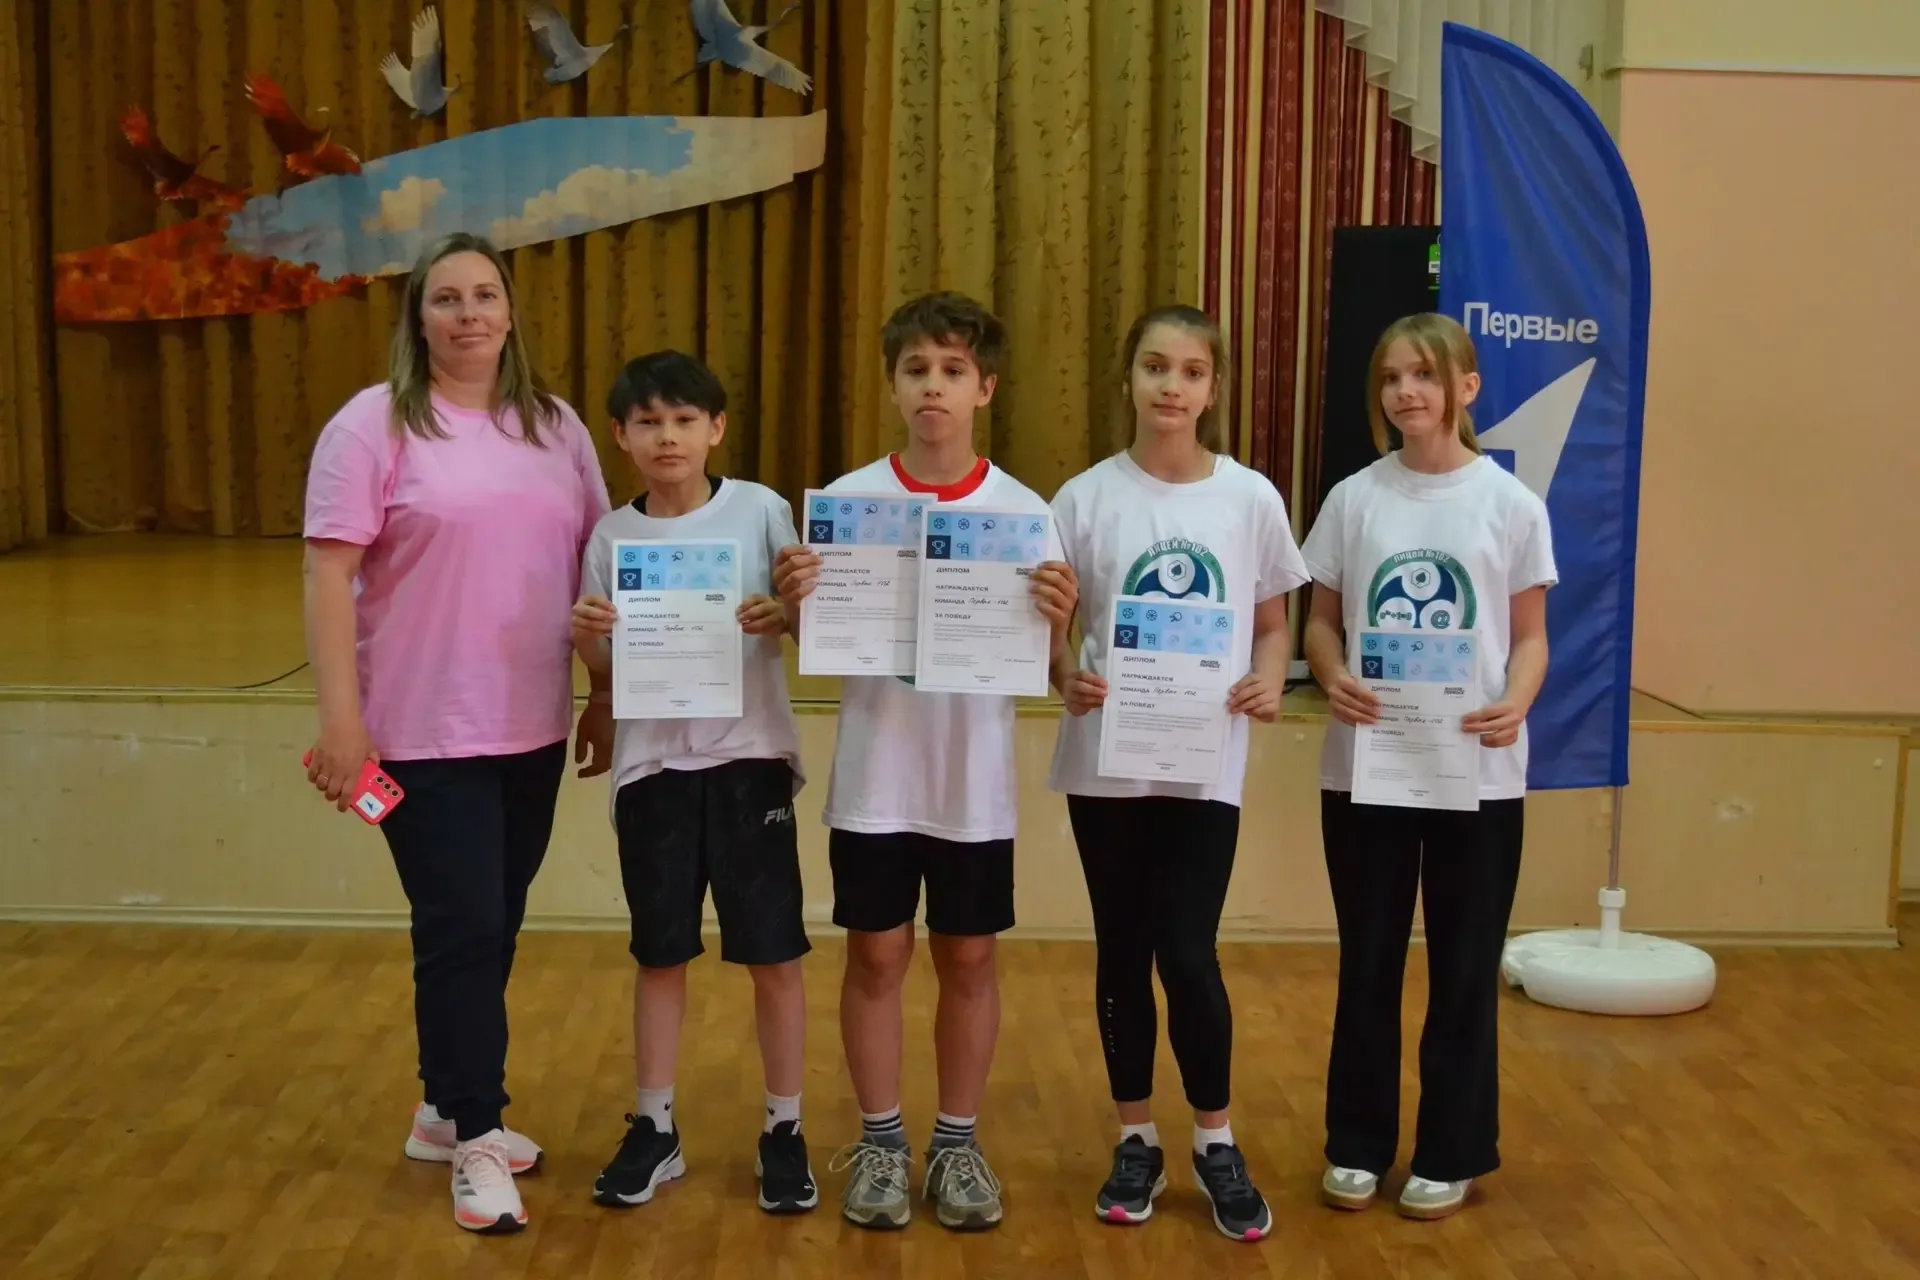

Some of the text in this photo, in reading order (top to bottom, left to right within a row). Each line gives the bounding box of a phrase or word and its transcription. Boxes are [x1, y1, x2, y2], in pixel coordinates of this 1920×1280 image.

[1464, 302, 1599, 349] Первые
[1147, 537, 1178, 557] ЛИЦЕЙ
[1121, 673, 1174, 682] НАГРАЖДАЕТСЯ
